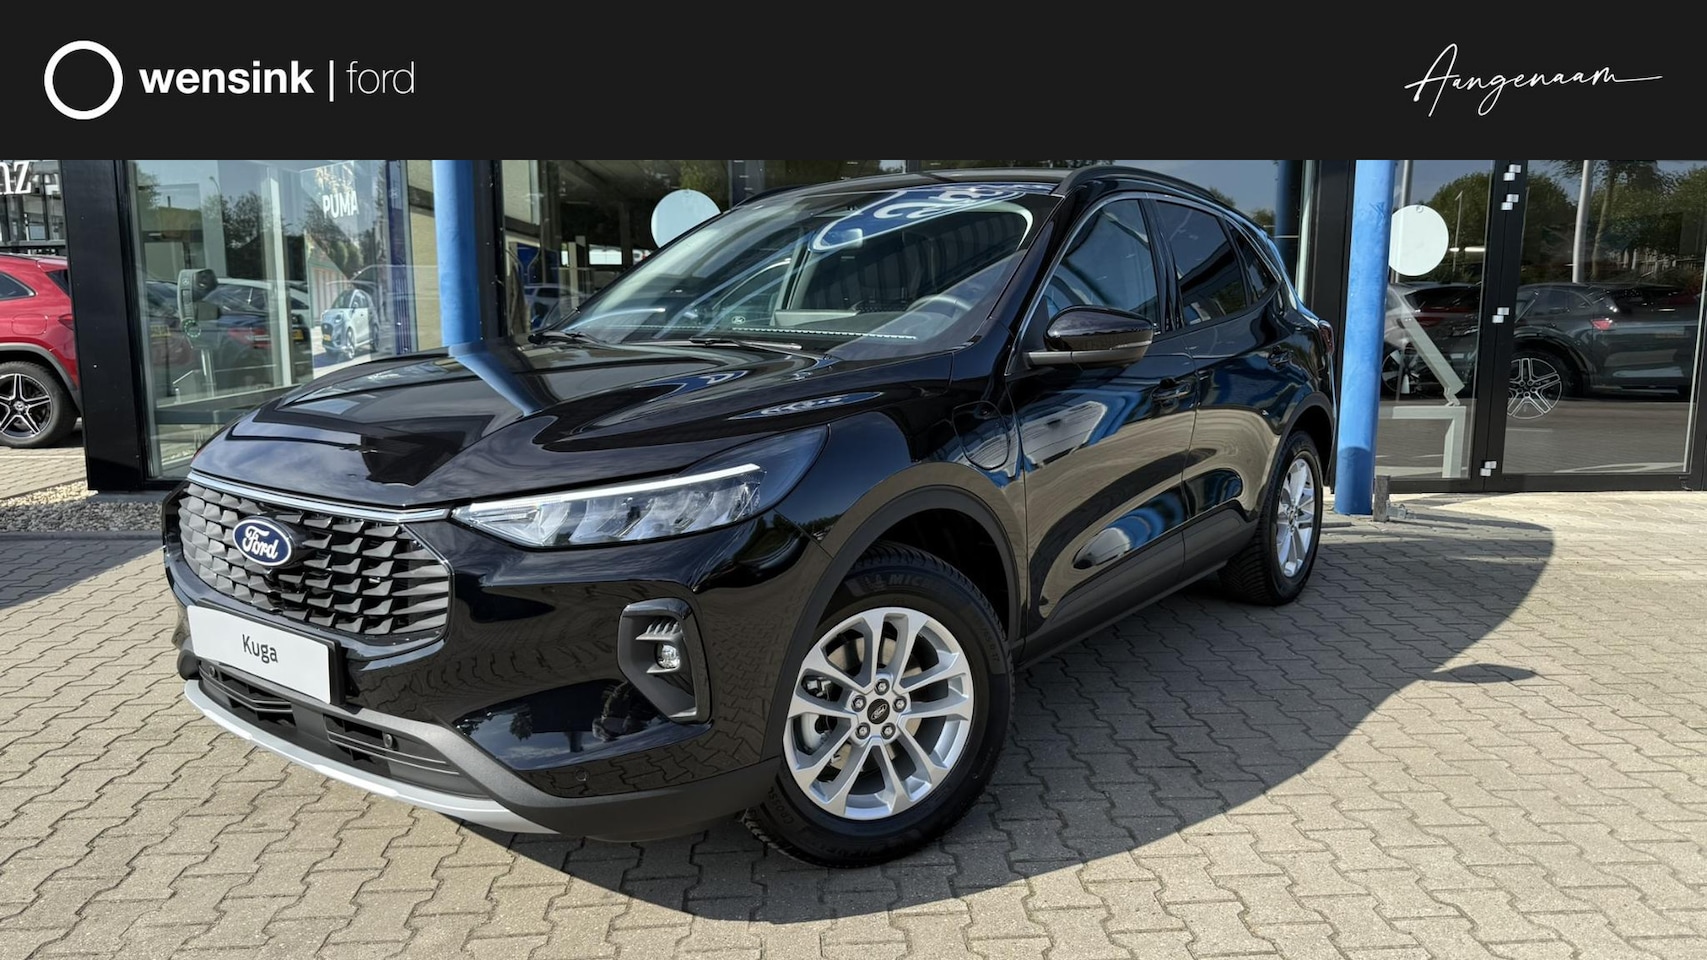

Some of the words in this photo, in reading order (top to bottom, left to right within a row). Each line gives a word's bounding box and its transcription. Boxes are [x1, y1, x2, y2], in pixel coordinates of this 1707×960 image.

[322, 191, 359, 219] PUMA
[242, 525, 279, 560] Ford
[242, 633, 279, 664] Kuga
